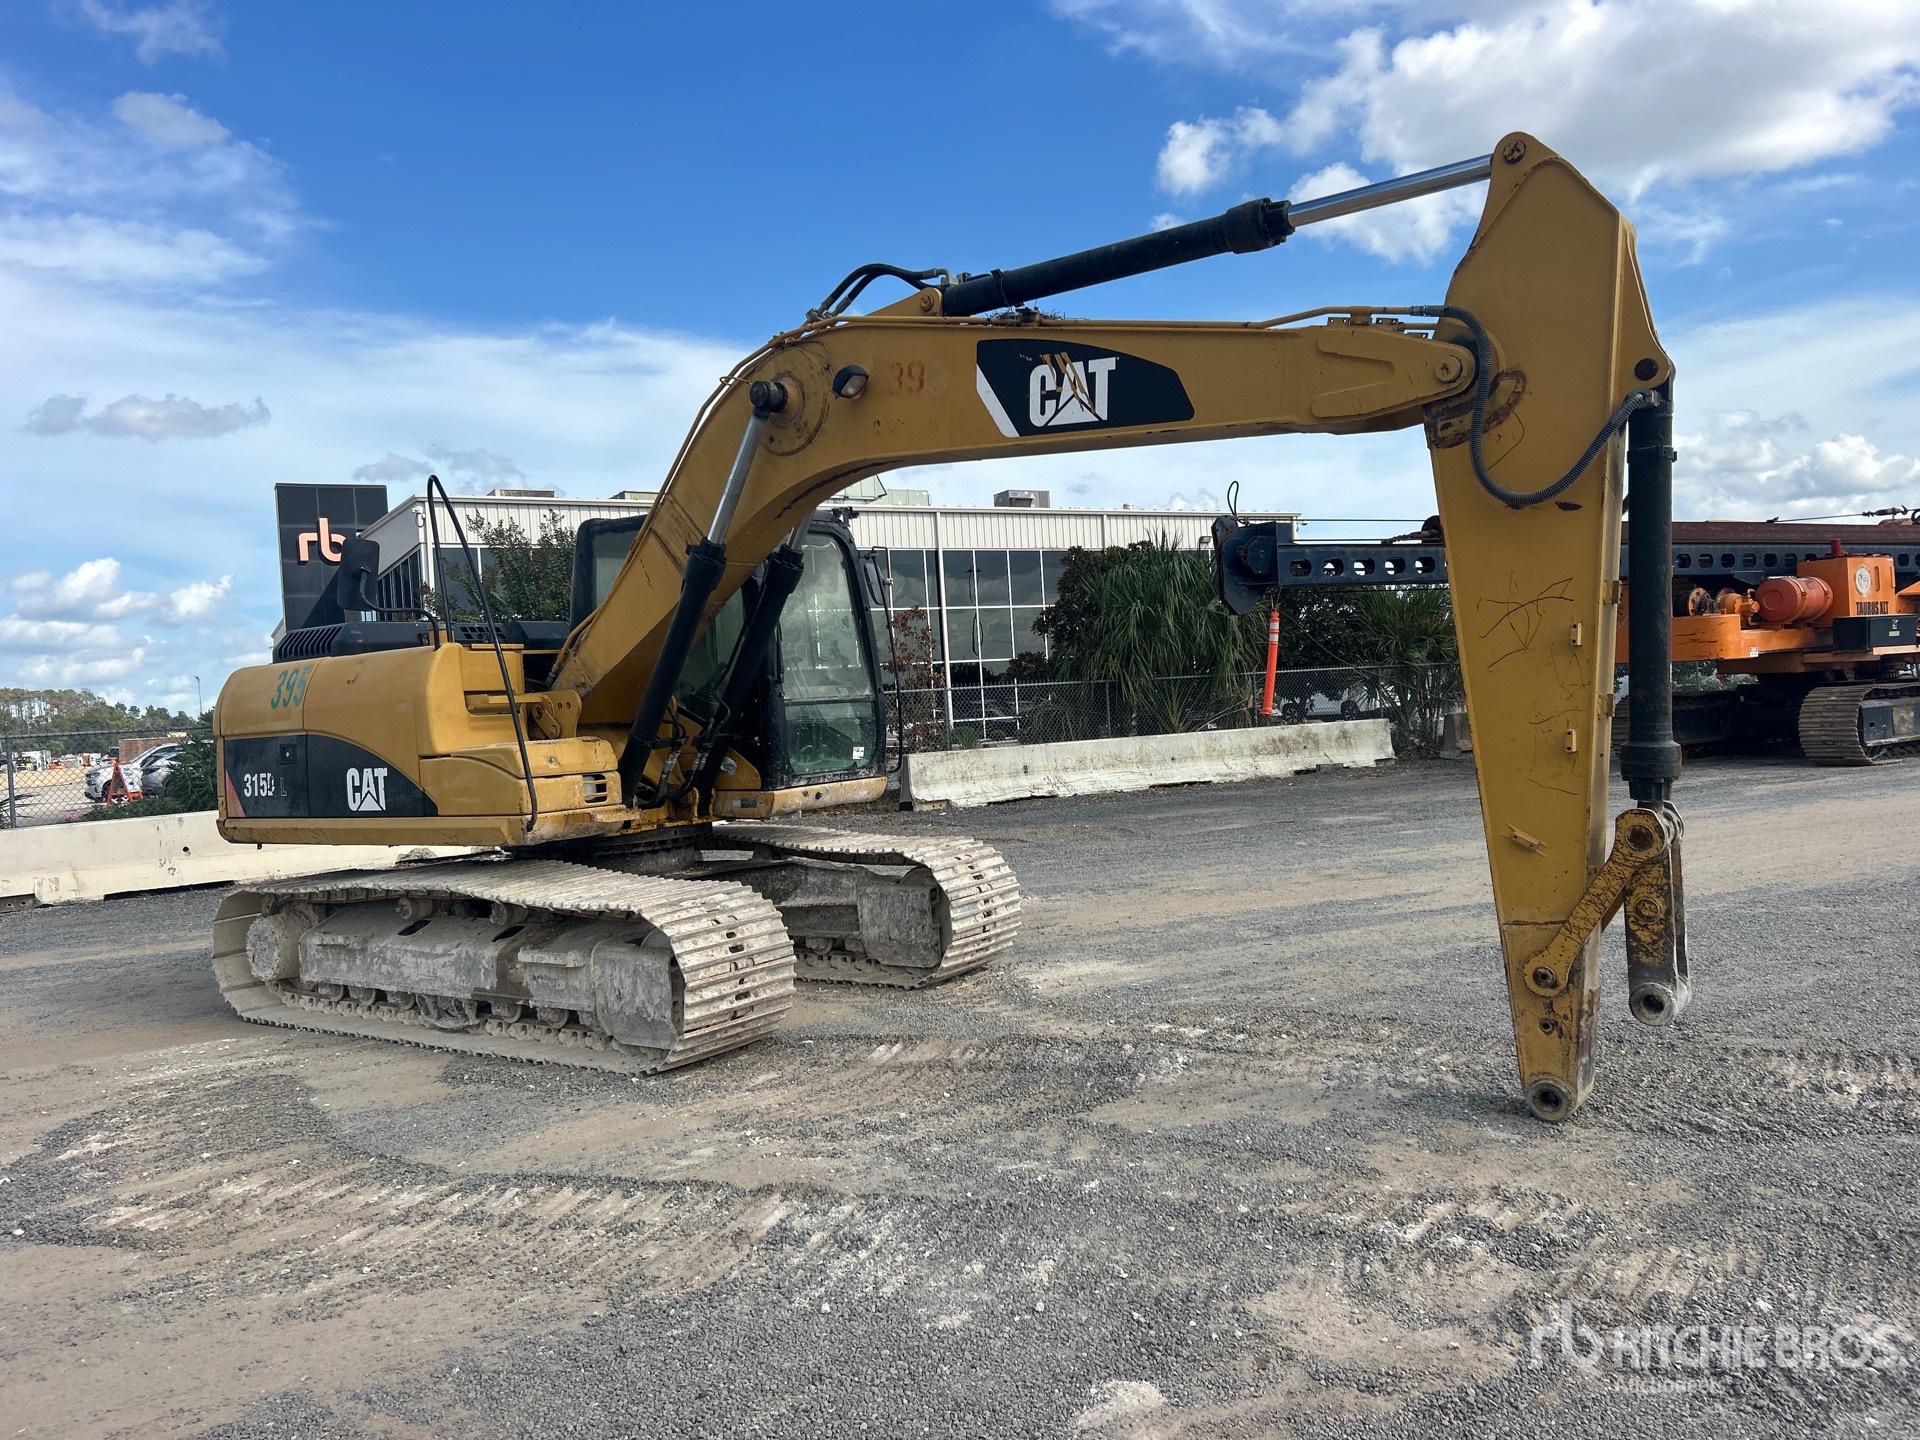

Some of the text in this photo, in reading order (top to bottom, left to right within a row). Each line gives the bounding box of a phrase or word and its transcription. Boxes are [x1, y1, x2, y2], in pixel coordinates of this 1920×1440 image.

[1029, 356, 1116, 427] CAT
[298, 517, 347, 562] rb
[270, 665, 312, 710] 395
[346, 767, 388, 812] CAT
